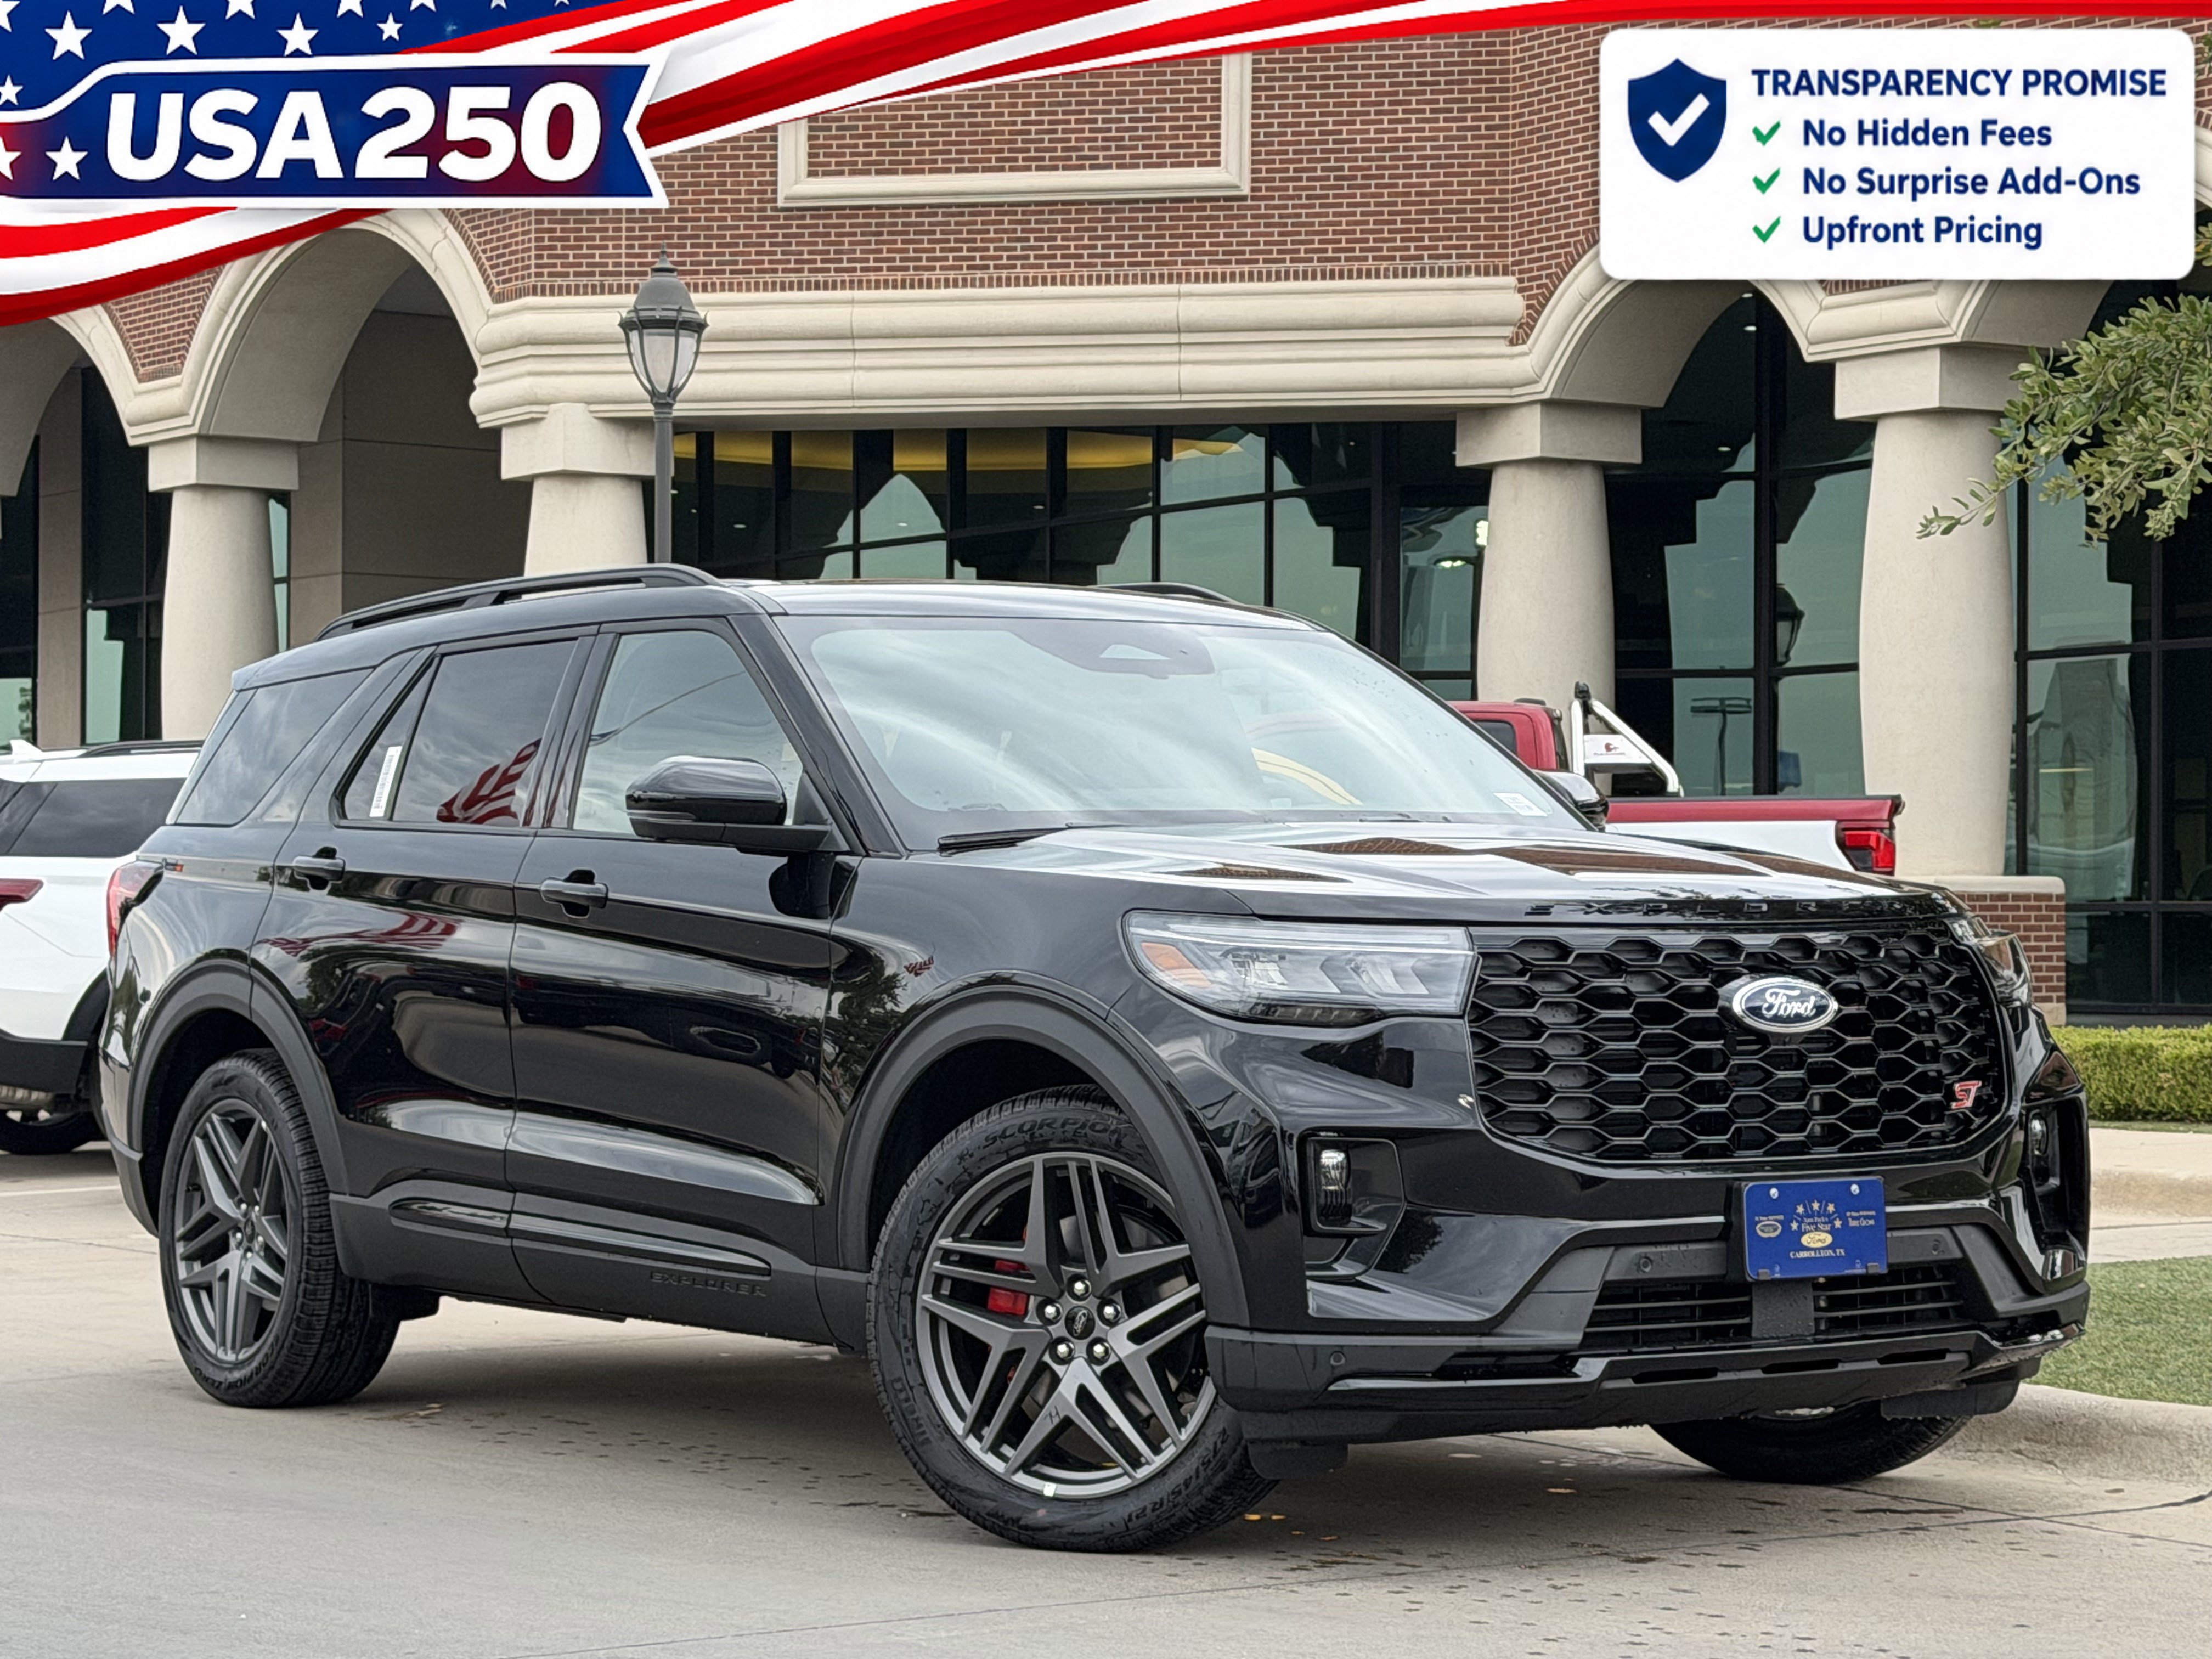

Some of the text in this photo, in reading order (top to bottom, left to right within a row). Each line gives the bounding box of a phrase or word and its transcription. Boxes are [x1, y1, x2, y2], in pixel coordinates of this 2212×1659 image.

[1762, 988, 1816, 1018] Ford
[1950, 1080, 1982, 1109] ST
[650, 1271, 766, 1297] EXPLORER
